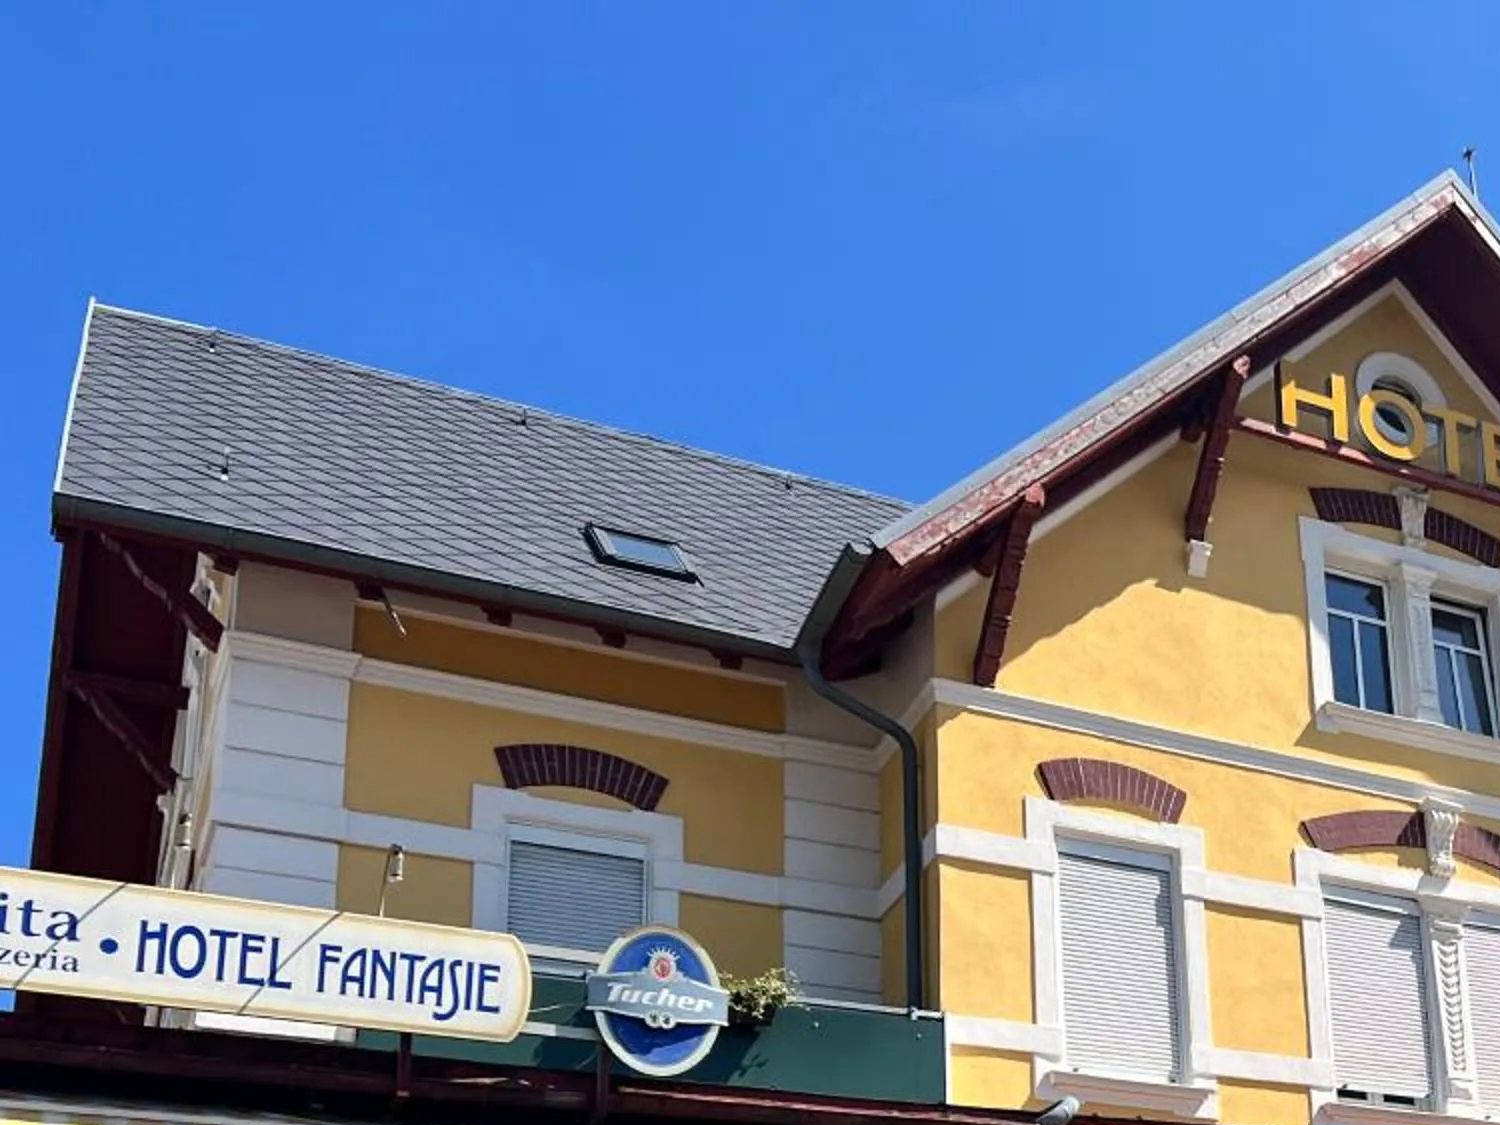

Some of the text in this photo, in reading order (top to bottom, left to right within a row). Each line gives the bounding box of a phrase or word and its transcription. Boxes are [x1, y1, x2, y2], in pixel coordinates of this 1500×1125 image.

[135, 919, 292, 990] HOTEL
[316, 943, 501, 1021] FANTASIE
[607, 981, 713, 1012] Tucher
